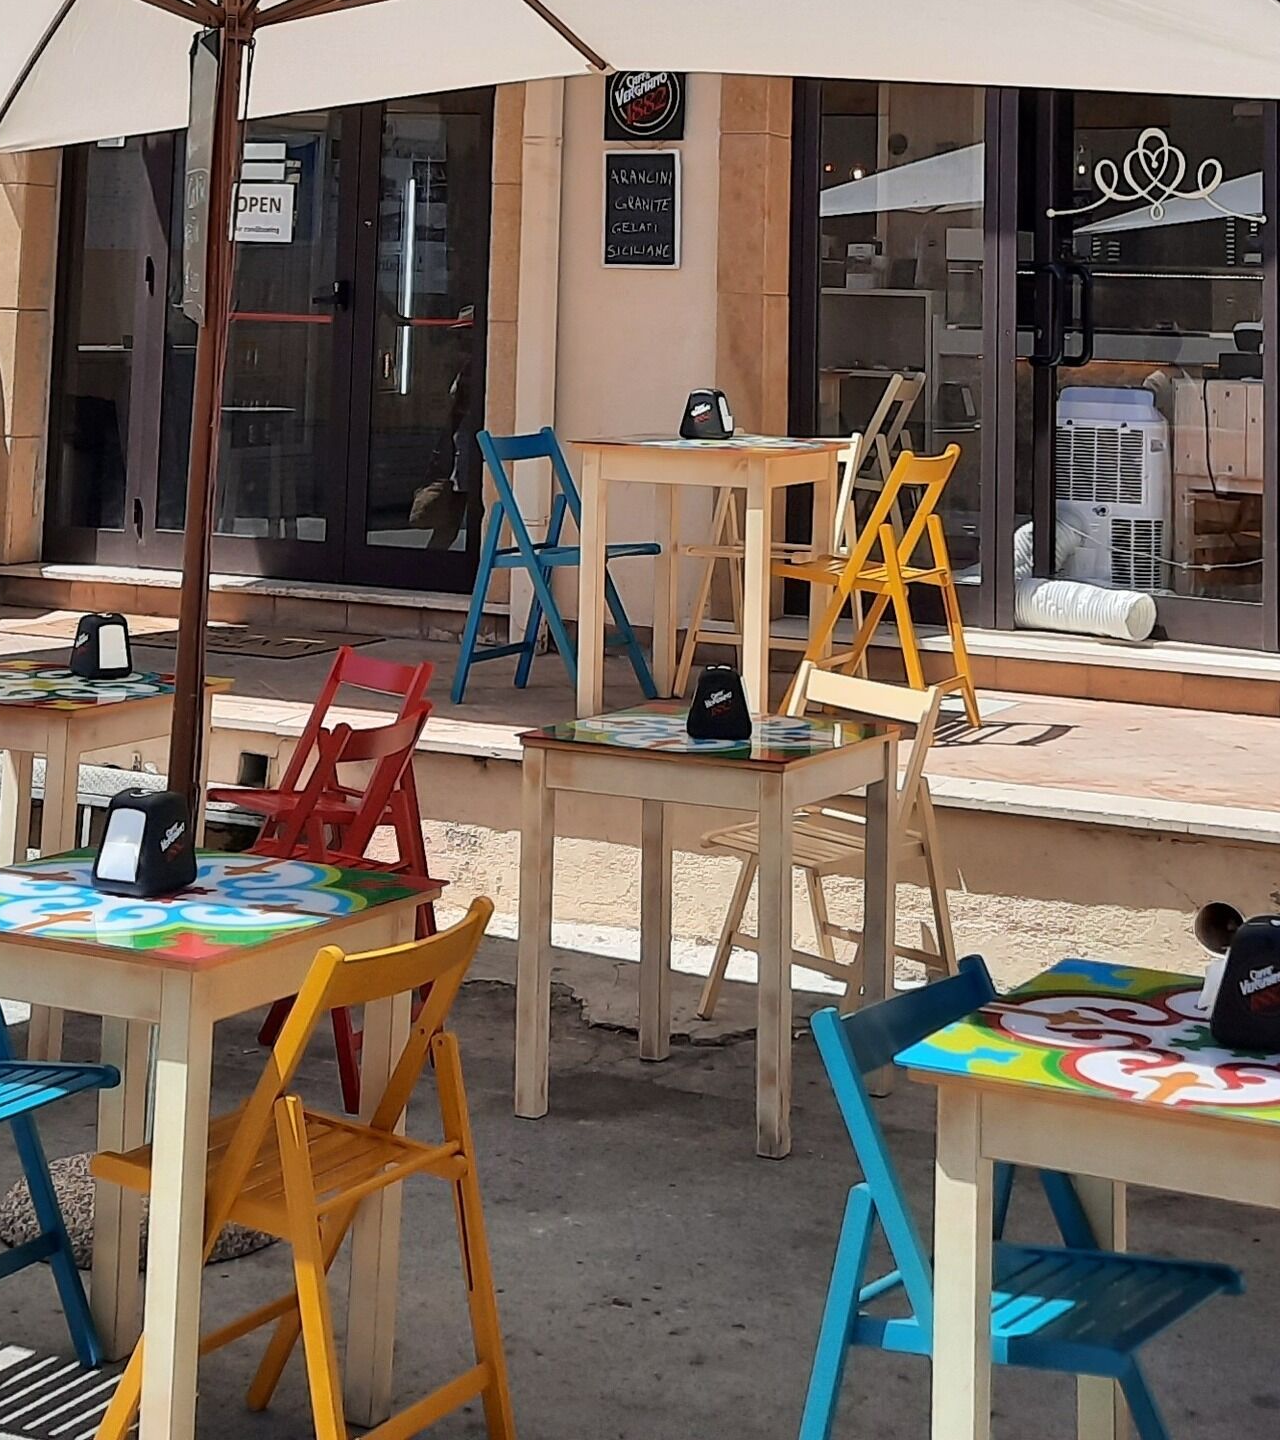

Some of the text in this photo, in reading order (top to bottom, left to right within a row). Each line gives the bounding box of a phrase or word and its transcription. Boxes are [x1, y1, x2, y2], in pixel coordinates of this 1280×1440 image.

[615, 72, 668, 109] VERGNANO
[626, 86, 667, 126] 1882
[610, 169, 672, 187] ARANCINI
[237, 196, 282, 214] OPEN
[614, 197, 671, 212] GRANITE
[611, 222, 658, 234] GELATI
